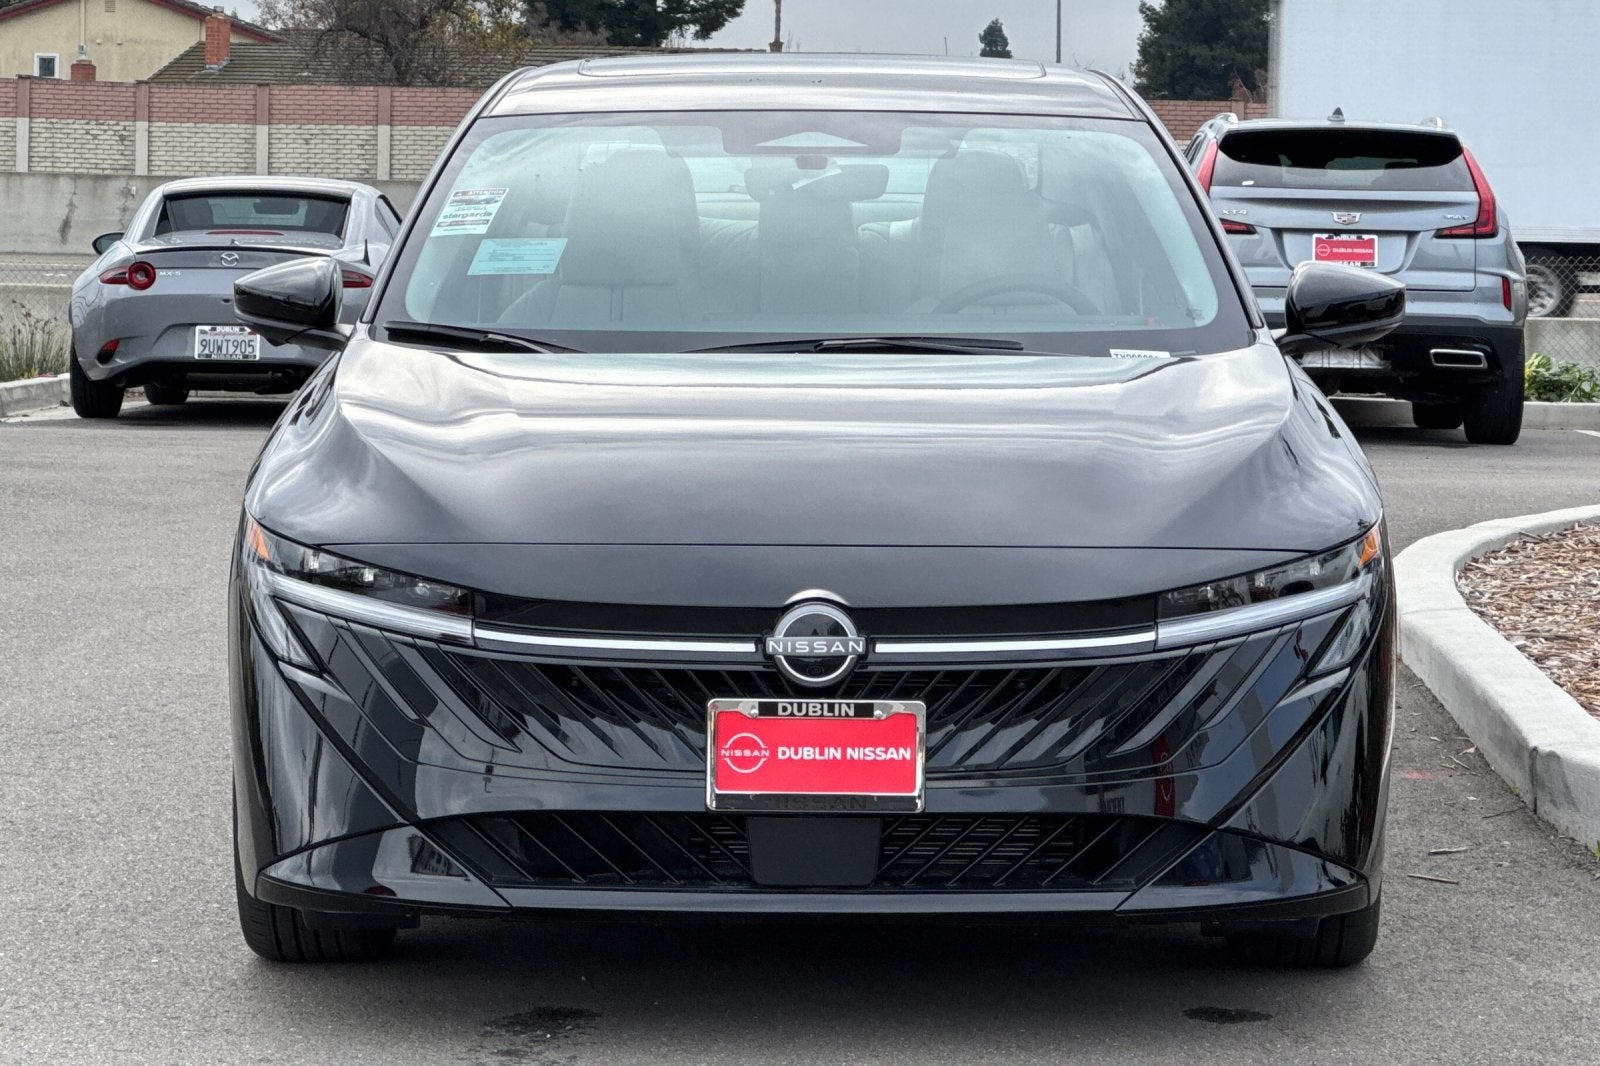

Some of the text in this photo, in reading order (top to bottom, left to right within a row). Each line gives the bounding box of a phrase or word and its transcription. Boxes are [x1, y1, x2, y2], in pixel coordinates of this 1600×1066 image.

[200, 338, 255, 354] 9UWT905
[768, 640, 864, 653] NISSAN
[777, 702, 855, 717] DUBLIN
[720, 748, 770, 758] NISSAN
[777, 746, 911, 760] DUBLIN NISSAN
